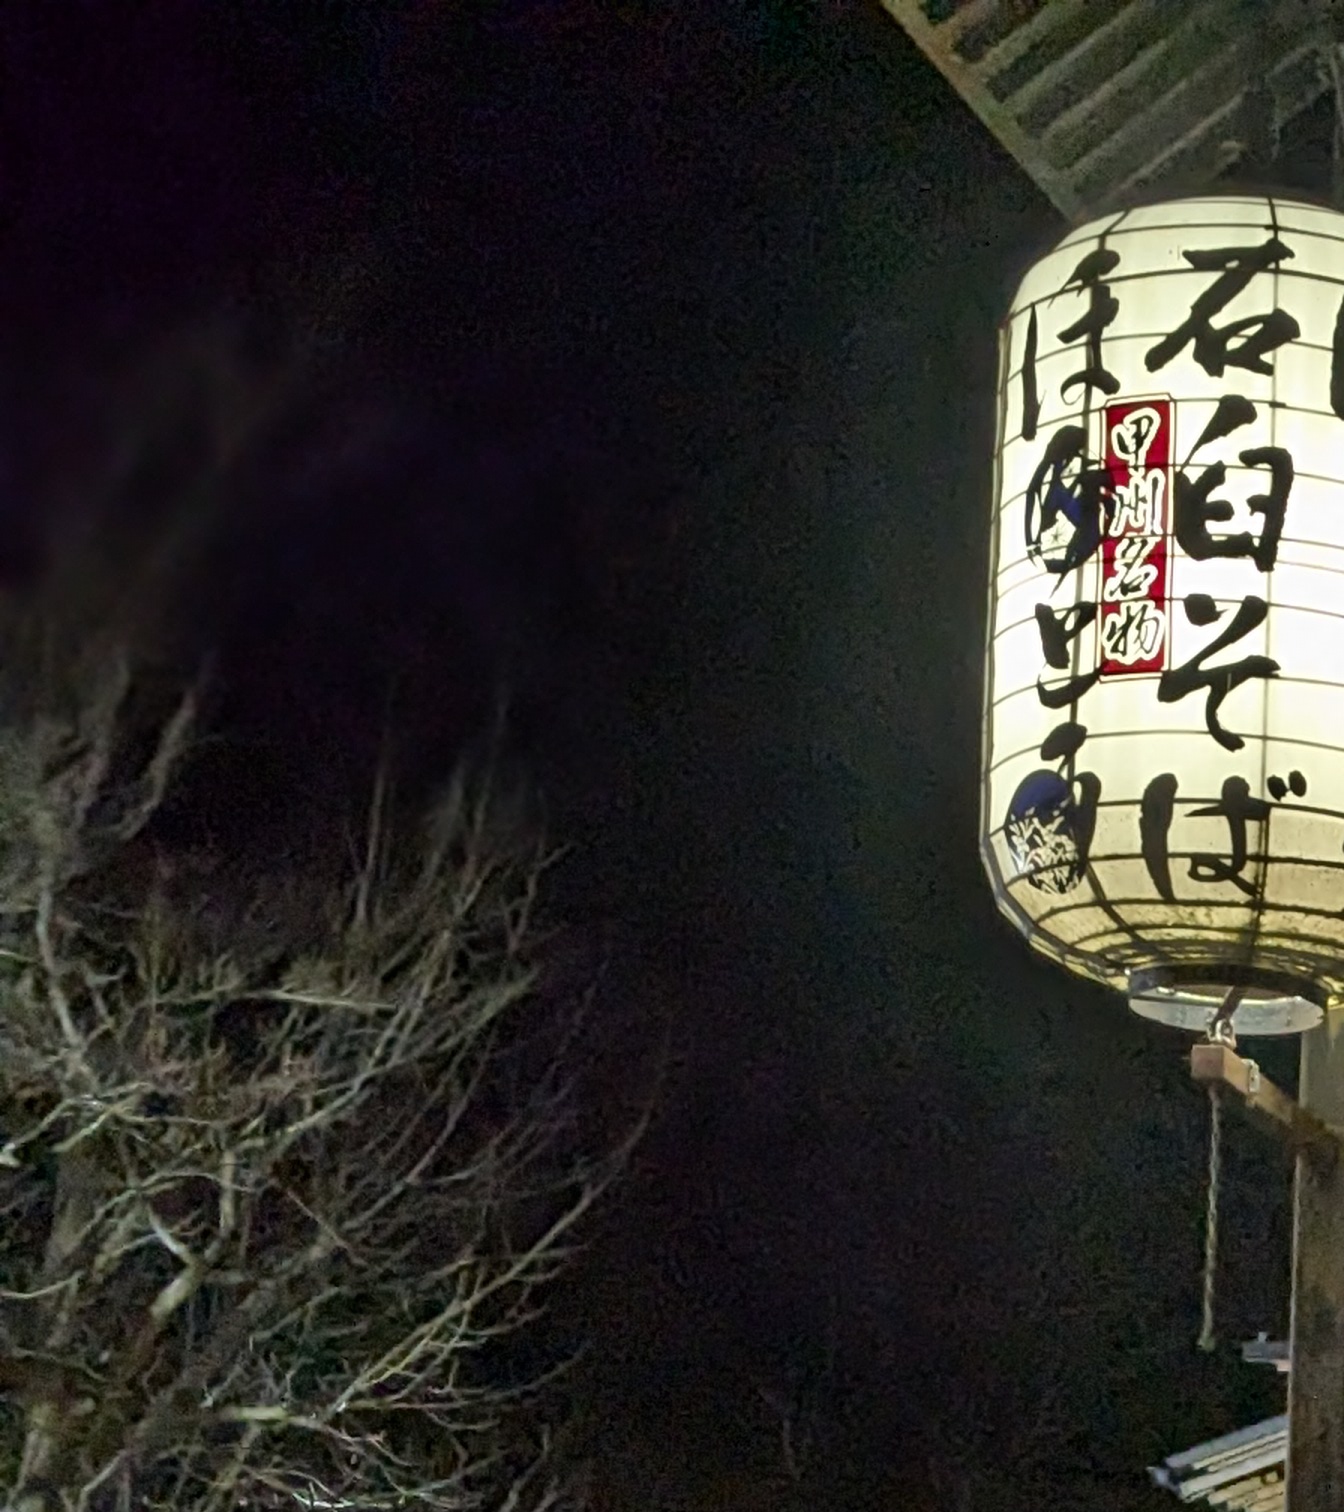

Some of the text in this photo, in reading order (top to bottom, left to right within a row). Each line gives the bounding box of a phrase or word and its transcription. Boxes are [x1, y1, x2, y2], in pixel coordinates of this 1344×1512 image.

[1100, 405, 1170, 664] 甲州名物
[1142, 238, 1307, 902] 石臼そば
